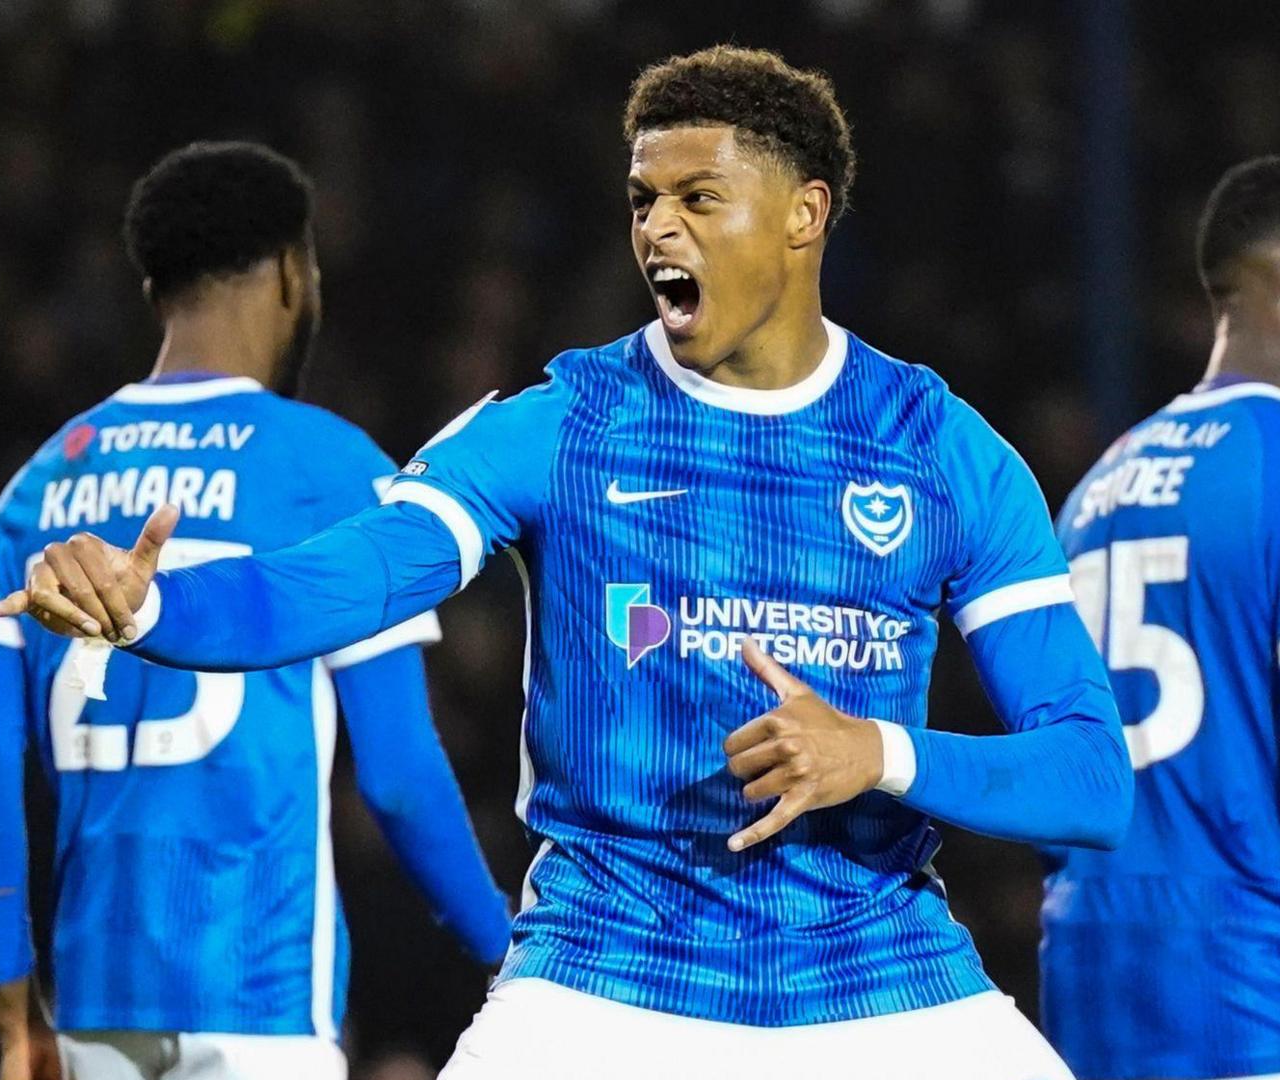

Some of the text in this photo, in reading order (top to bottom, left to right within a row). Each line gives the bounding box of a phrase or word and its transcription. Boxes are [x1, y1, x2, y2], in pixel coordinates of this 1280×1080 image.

[38, 465, 237, 531] KAMARA
[680, 596, 912, 641] UNIVERSITY OF
[680, 629, 903, 671] PORTSMOUTH
